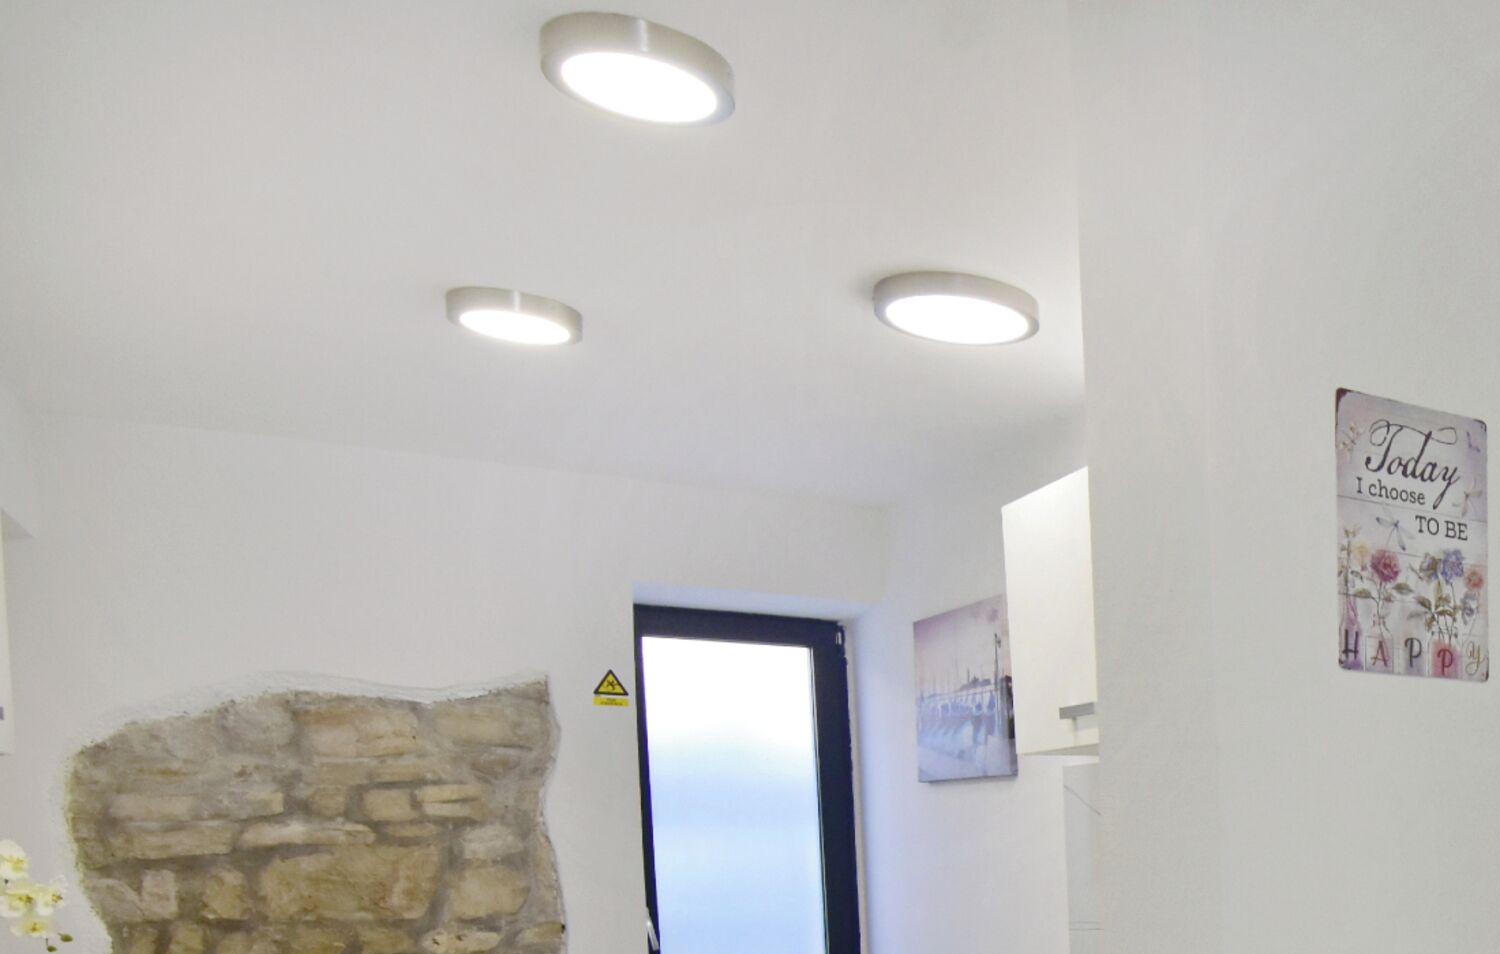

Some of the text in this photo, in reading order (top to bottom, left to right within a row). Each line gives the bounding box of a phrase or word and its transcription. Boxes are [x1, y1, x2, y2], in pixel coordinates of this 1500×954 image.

[1365, 419, 1460, 510] Today
[1356, 477, 1426, 506] I choose
[1415, 515, 1468, 541] TO BE
